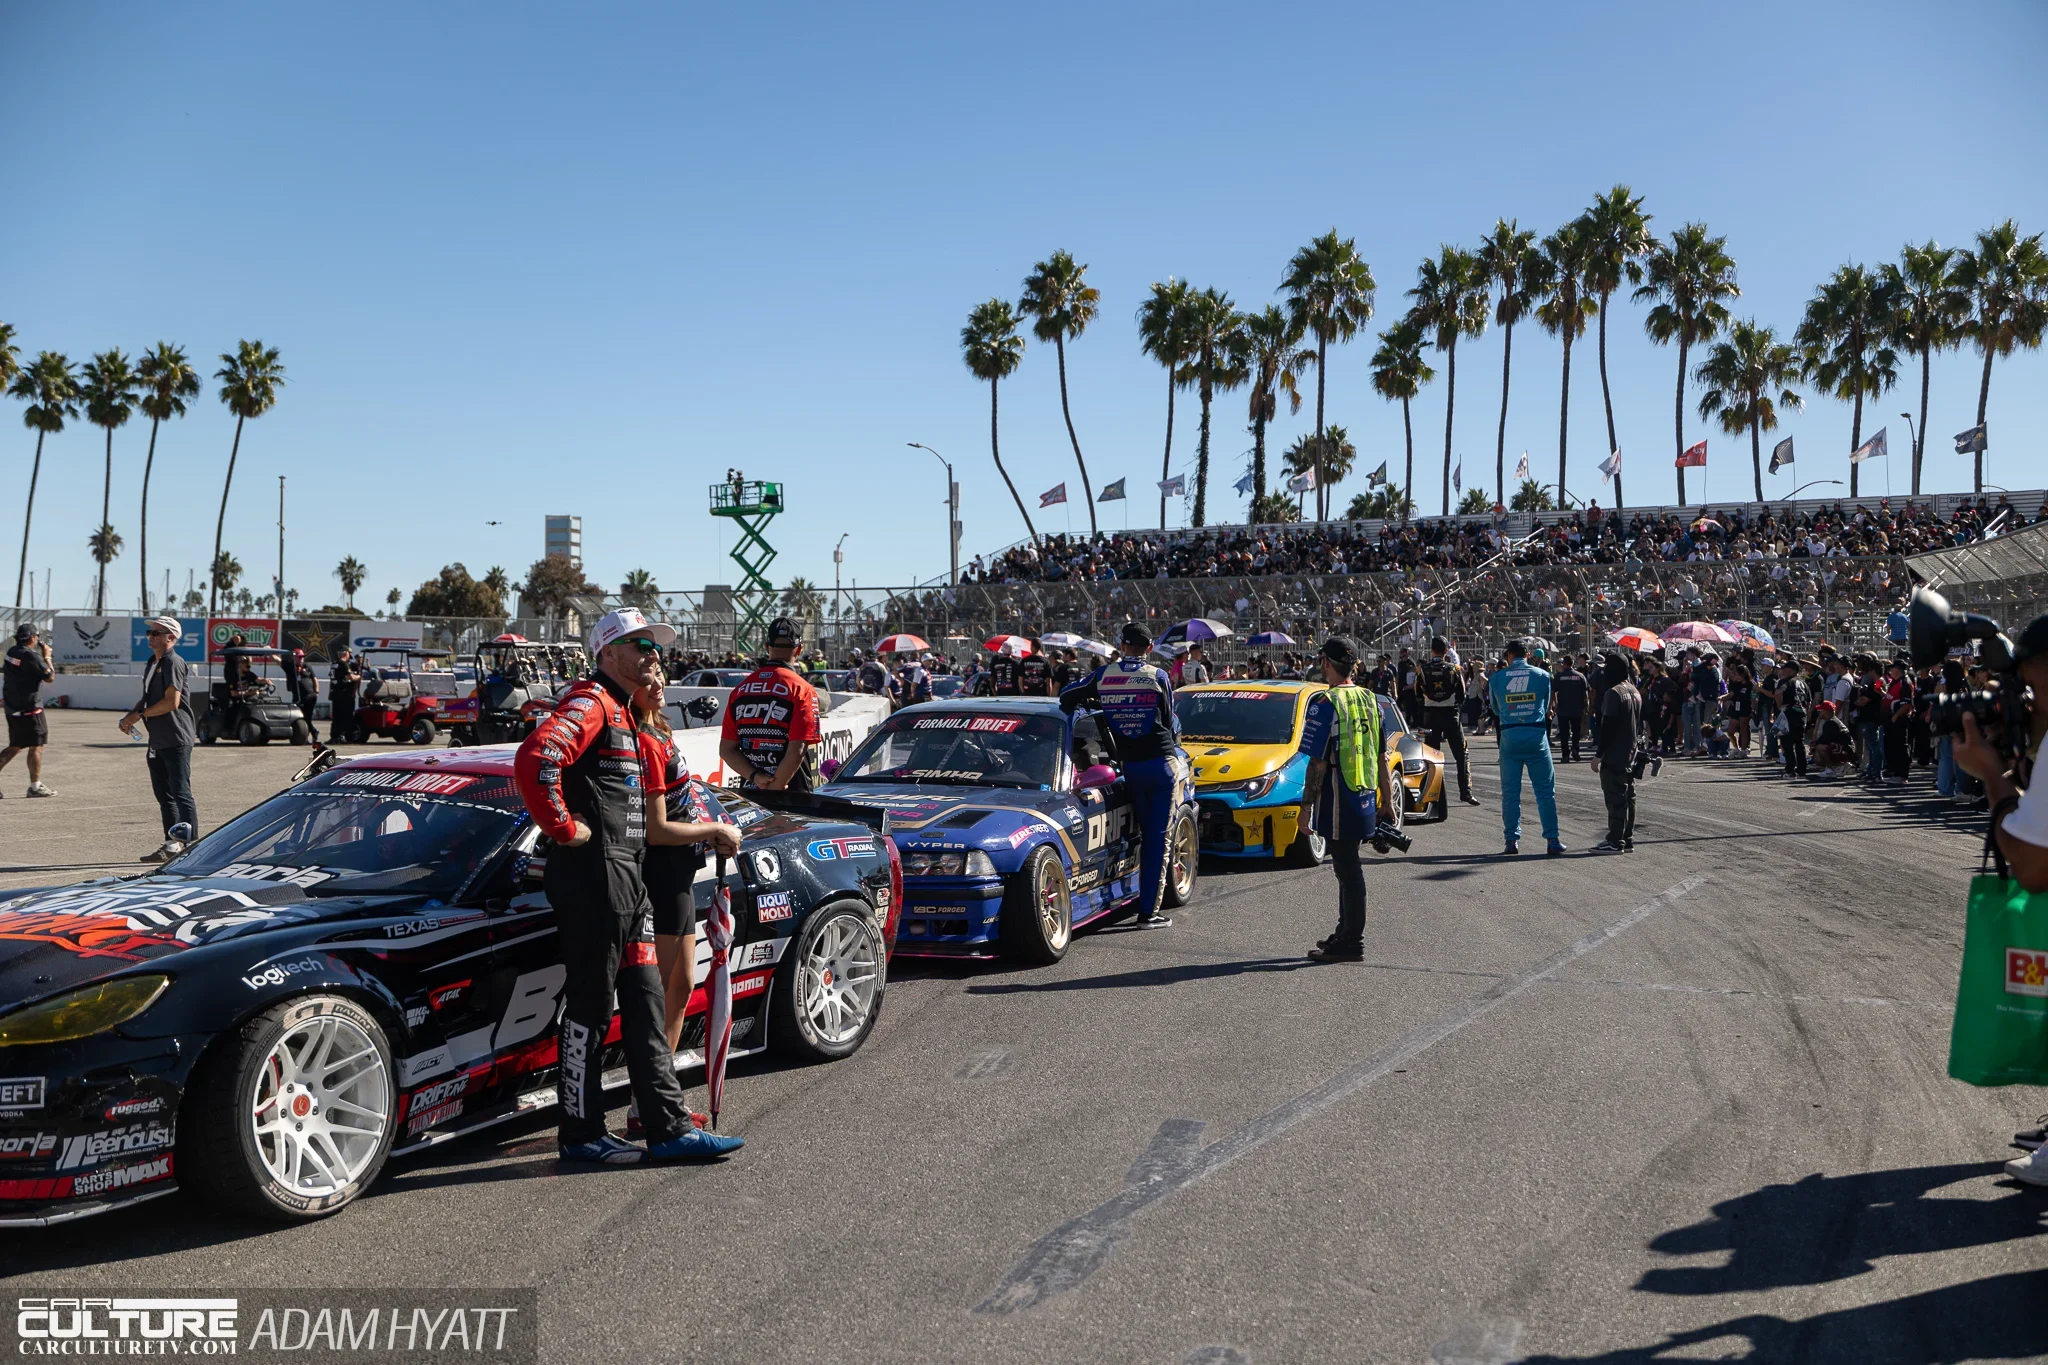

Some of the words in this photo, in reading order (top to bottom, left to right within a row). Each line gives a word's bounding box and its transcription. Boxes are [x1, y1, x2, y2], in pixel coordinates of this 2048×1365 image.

[737, 682, 789, 696] FIELD
[1506, 675, 1530, 693] 411
[1233, 692, 1268, 700] DRIFT
[735, 700, 789, 724] Borla
[913, 718, 971, 730] FORMULA
[970, 718, 1018, 732] DRIFT
[543, 748, 562, 760] BMS
[911, 769, 984, 780] SIMHQ
[331, 773, 413, 789] FORMULA
[402, 773, 474, 794] DRIFT
[848, 843, 876, 852] RADIAL
[758, 893, 788, 909] LIQUI
[759, 904, 792, 921] MOLY
[383, 917, 440, 938] TEXAS
[241, 956, 325, 991] logitech
[0, 1084, 38, 1103] EFT
[0, 1132, 57, 1157] orla
[74, 1172, 113, 1186] PARTS
[75, 1180, 114, 1196] SHOP
[113, 1157, 170, 1187] MAX
